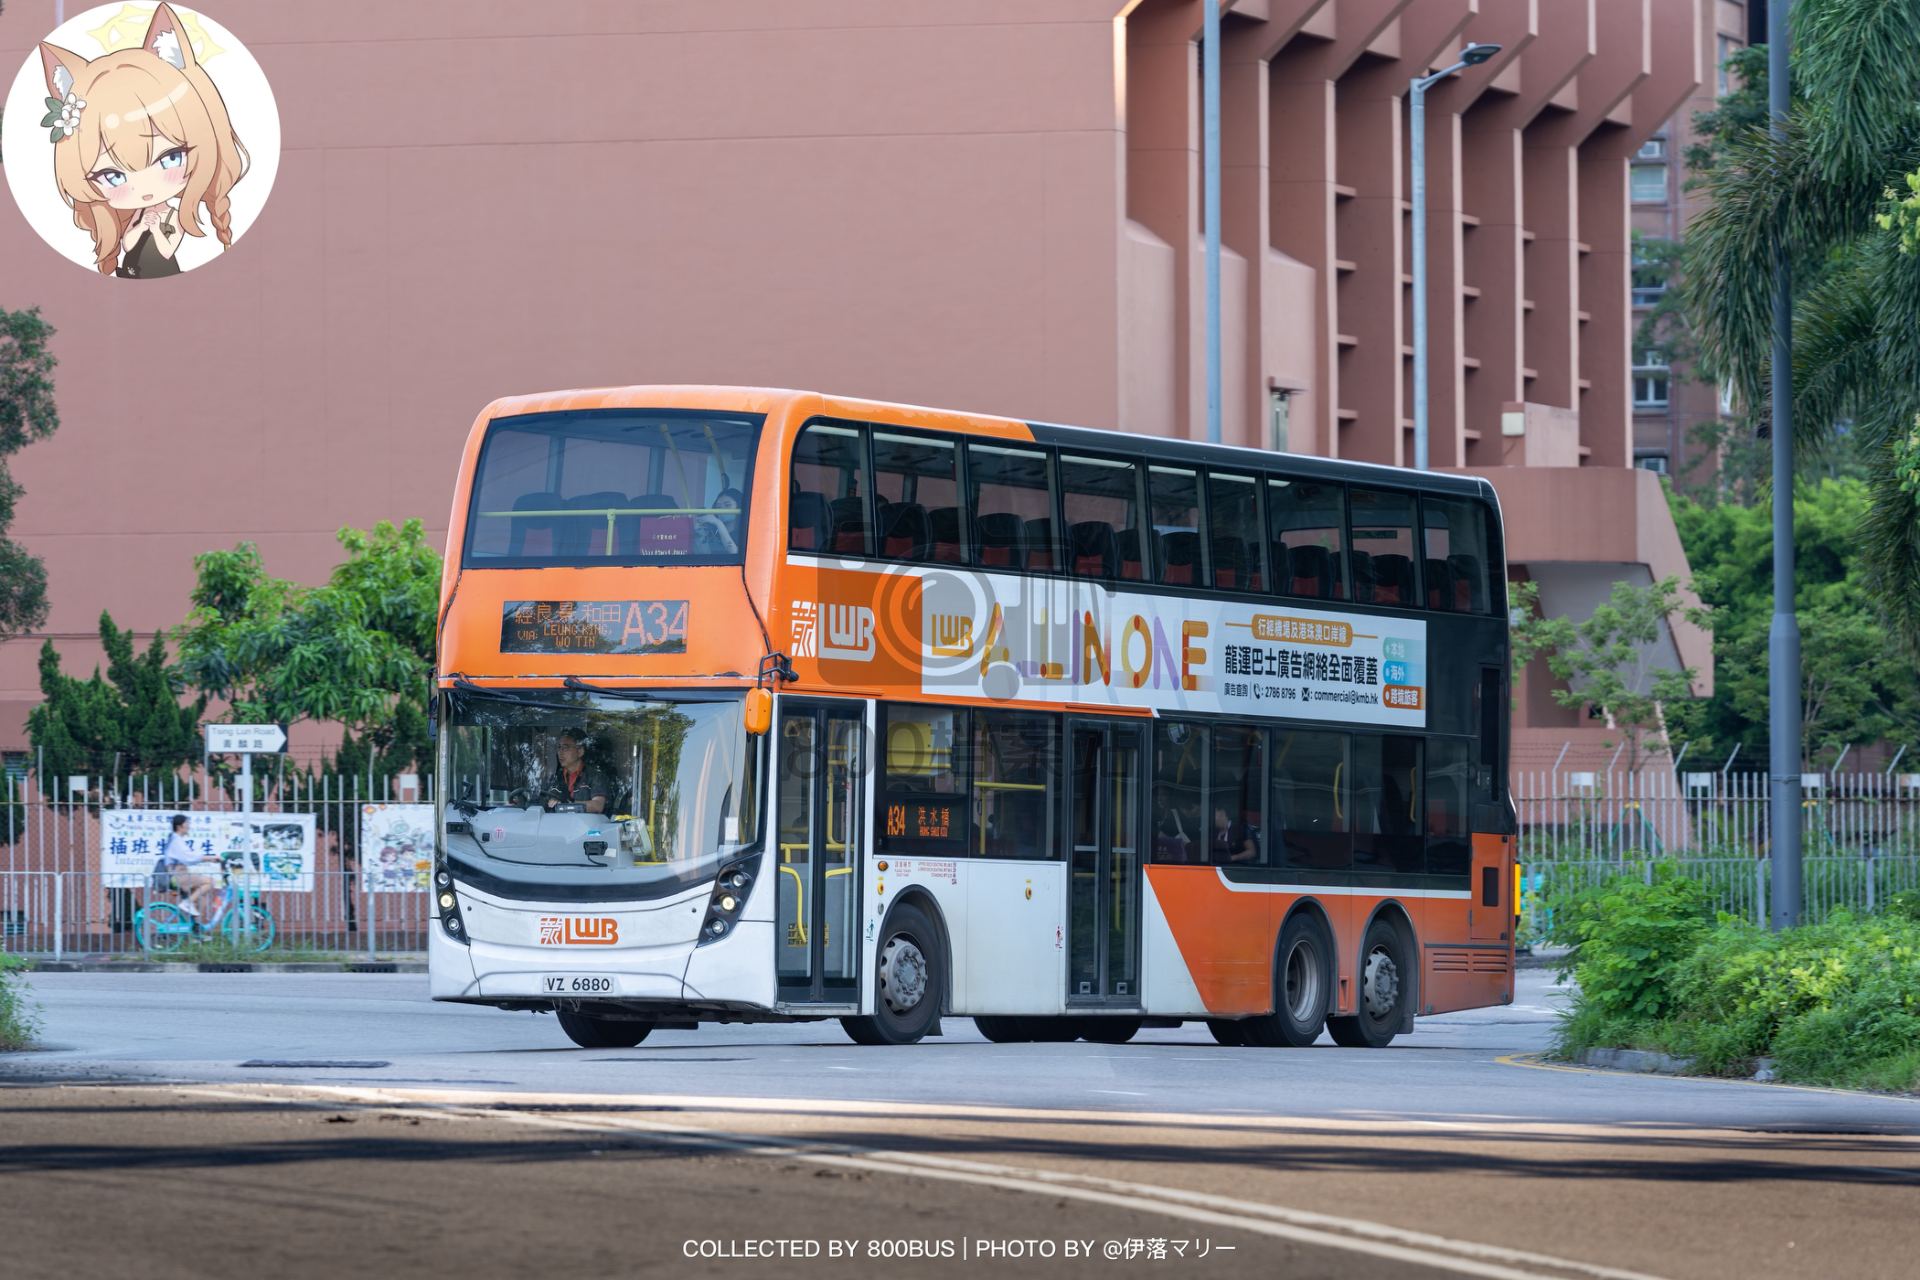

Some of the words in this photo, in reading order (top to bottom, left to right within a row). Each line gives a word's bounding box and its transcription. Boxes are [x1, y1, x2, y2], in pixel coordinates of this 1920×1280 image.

[544, 624, 578, 636] LEUNG
[621, 601, 689, 645] A34
[817, 602, 876, 663] LWB
[932, 614, 974, 658] LWB
[555, 635, 570, 648] WO
[576, 635, 596, 648] TIN
[1121, 613, 1210, 691] ONE
[1225, 644, 1378, 685] 龍運巴士廣告網絡全面覆蓋
[1390, 664, 1405, 681] 海外
[1264, 685, 1280, 699] 2786
[1281, 687, 1296, 700] 8796
[1314, 689, 1379, 705] commercial@kmb.hk
[212, 727, 233, 737] Tsing
[236, 727, 252, 735] Lun
[254, 727, 276, 735] Road
[887, 805, 906, 836] A34
[115, 856, 154, 865] Interim
[565, 918, 619, 945] LWB
[547, 978, 565, 991] VZ
[572, 978, 610, 991] 6880
